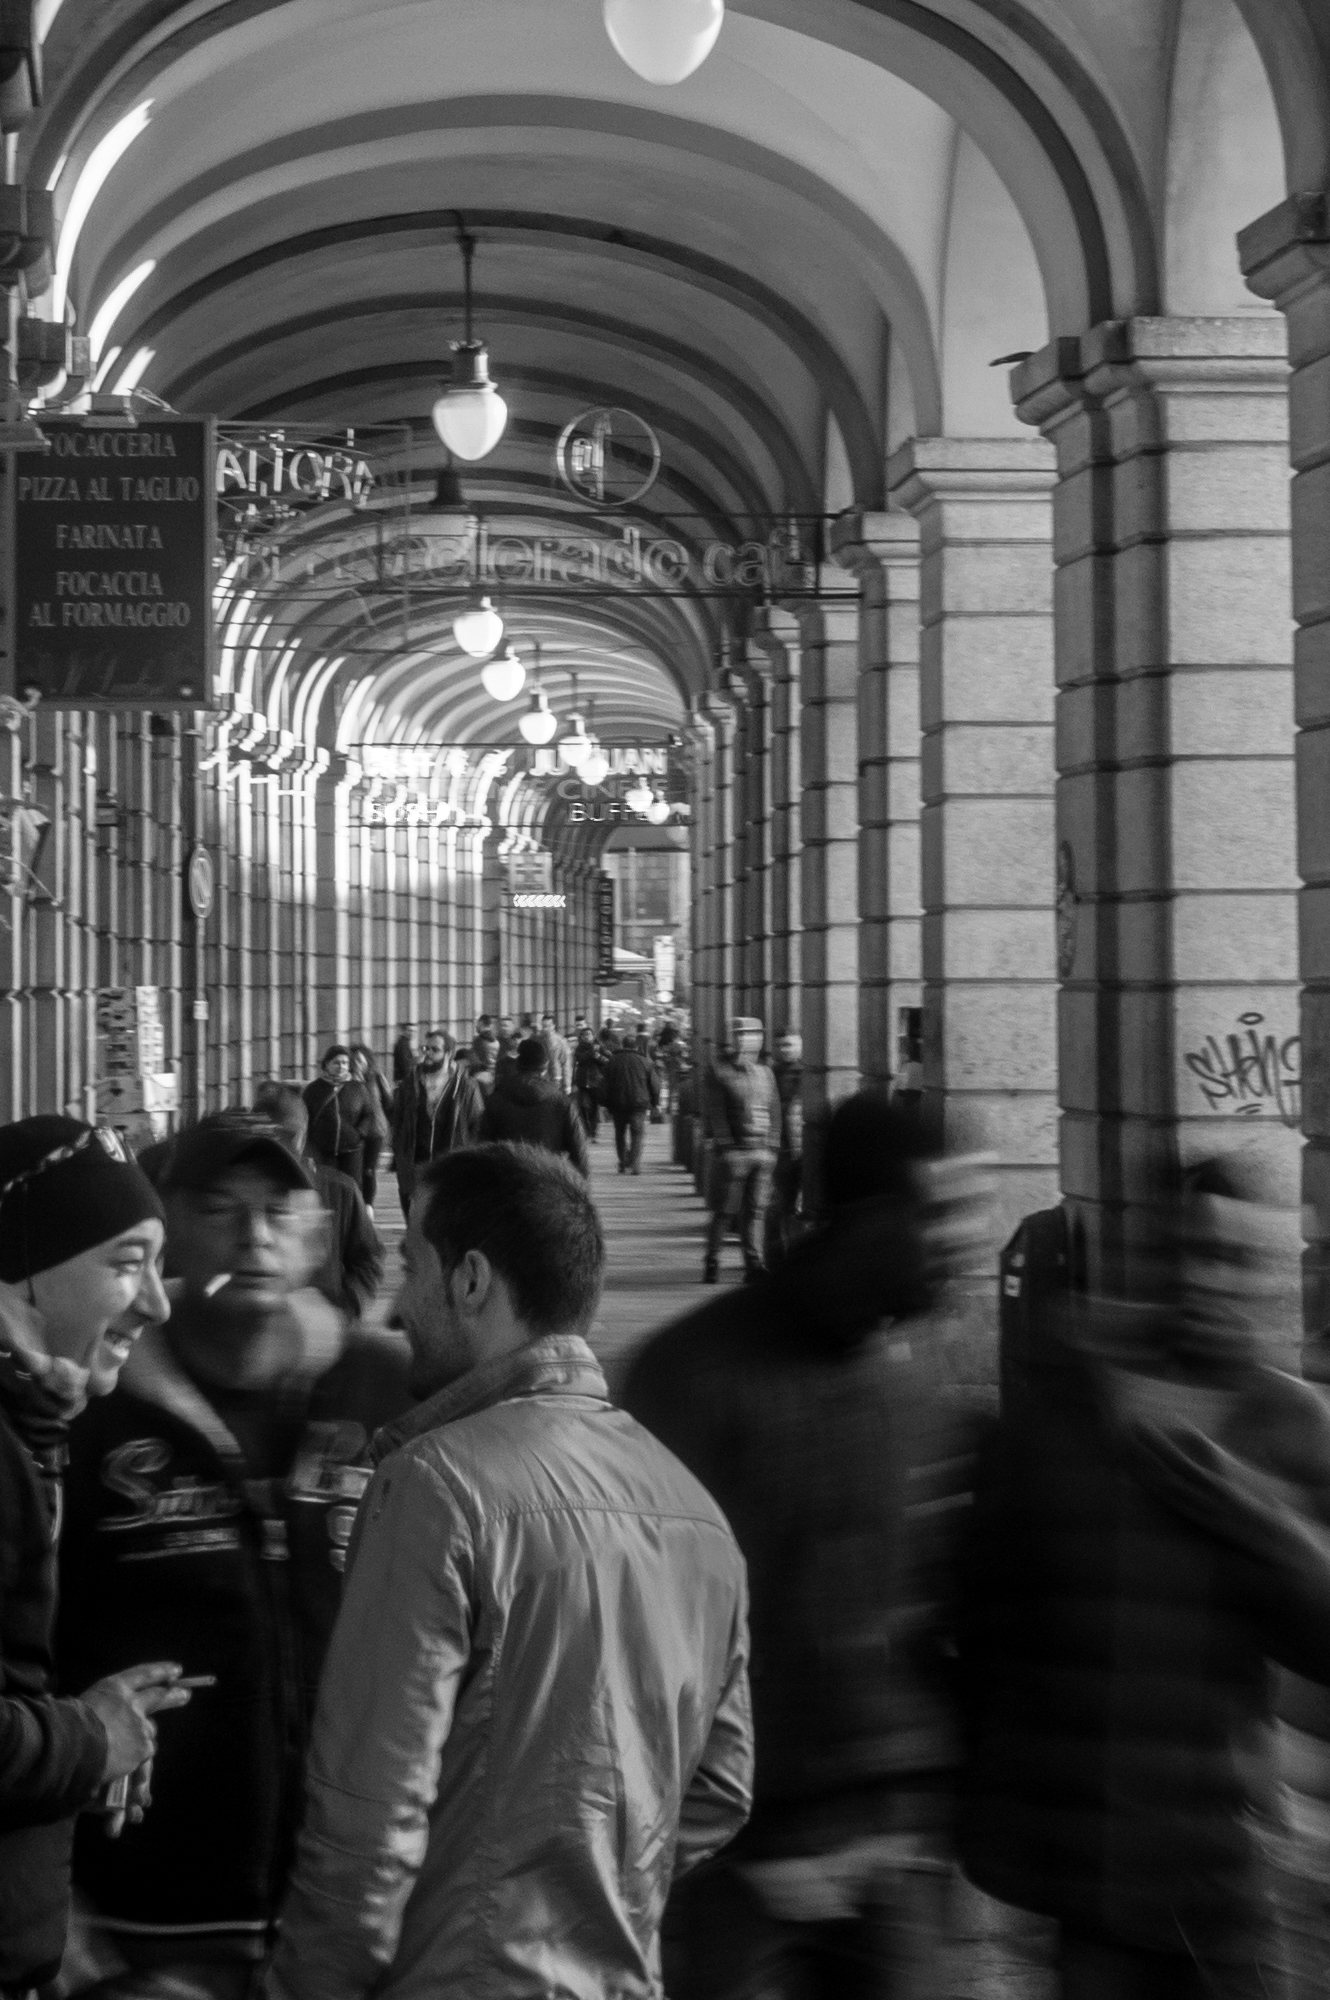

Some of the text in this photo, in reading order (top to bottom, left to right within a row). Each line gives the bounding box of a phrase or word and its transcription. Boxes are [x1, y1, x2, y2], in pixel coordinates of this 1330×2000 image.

[18, 476, 200, 501] PIZZA AL TAGLIO
[55, 524, 163, 549] FARINATA
[56, 571, 163, 596] FOCACCIA
[29, 602, 190, 627] AL FORMAGGIO
